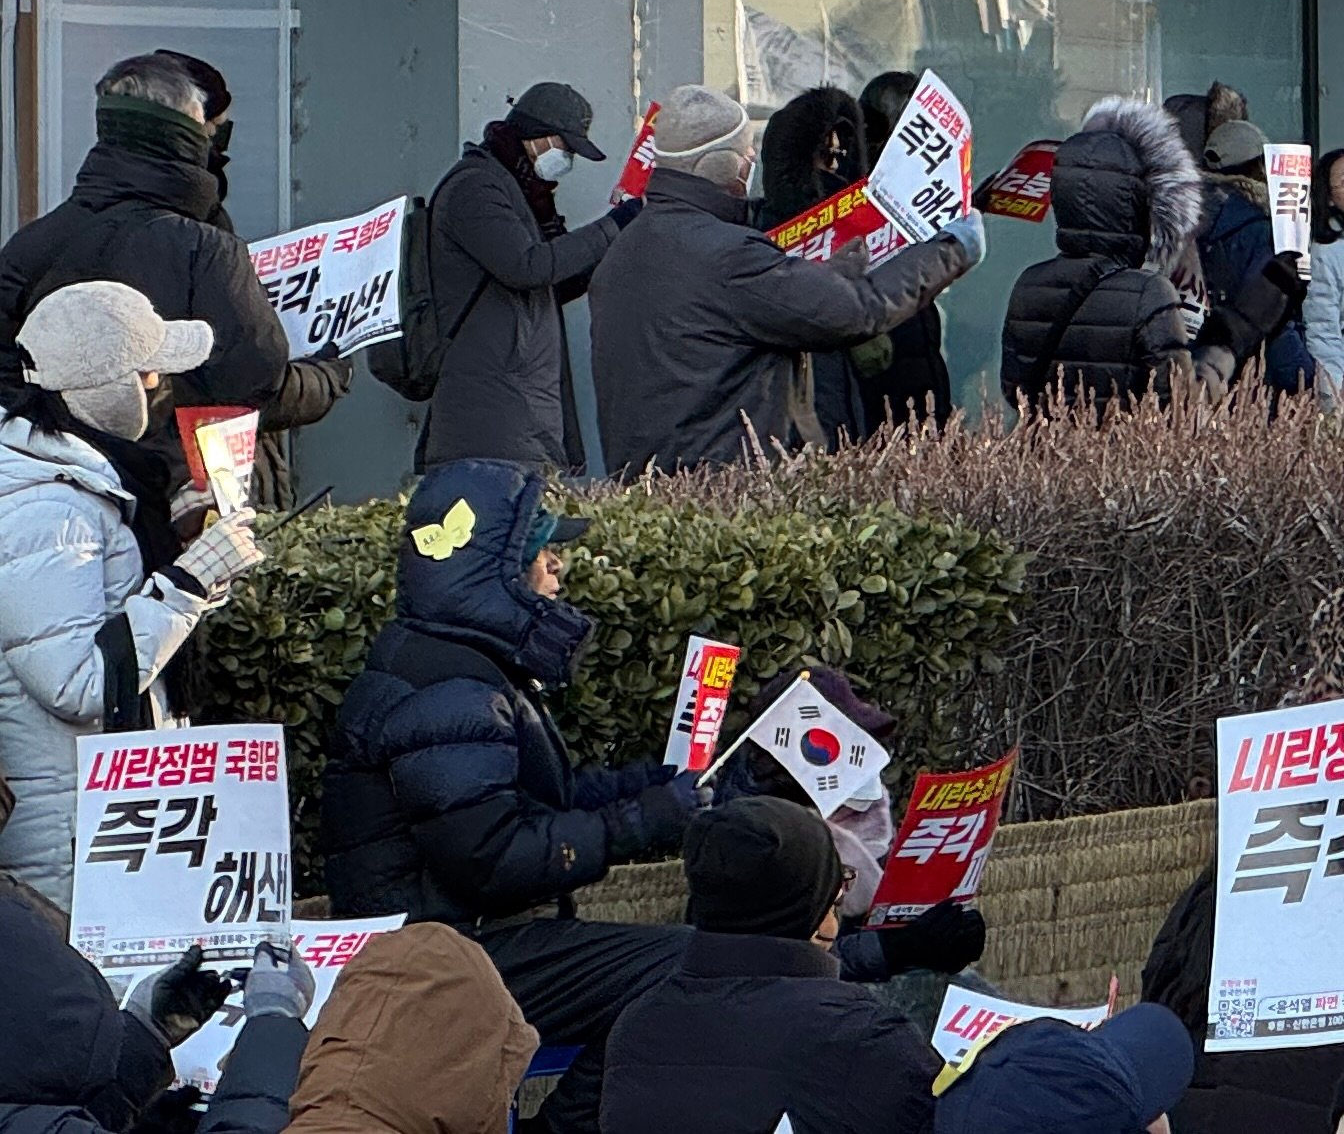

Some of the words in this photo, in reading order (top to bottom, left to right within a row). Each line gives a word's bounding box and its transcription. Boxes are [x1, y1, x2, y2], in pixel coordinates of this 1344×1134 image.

[896, 113, 952, 175] 즉각
[249, 233, 328, 277] 란정범
[332, 208, 397, 254] 국힘당
[308, 269, 394, 344] 해산!
[85, 742, 218, 791] 내란정범
[225, 740, 280, 782] 국힘당
[86, 795, 217, 873] 즉각
[896, 809, 988, 865] 즉각
[1268, 997, 1312, 1015] <윤석열
[1315, 994, 1338, 1009] 파면
